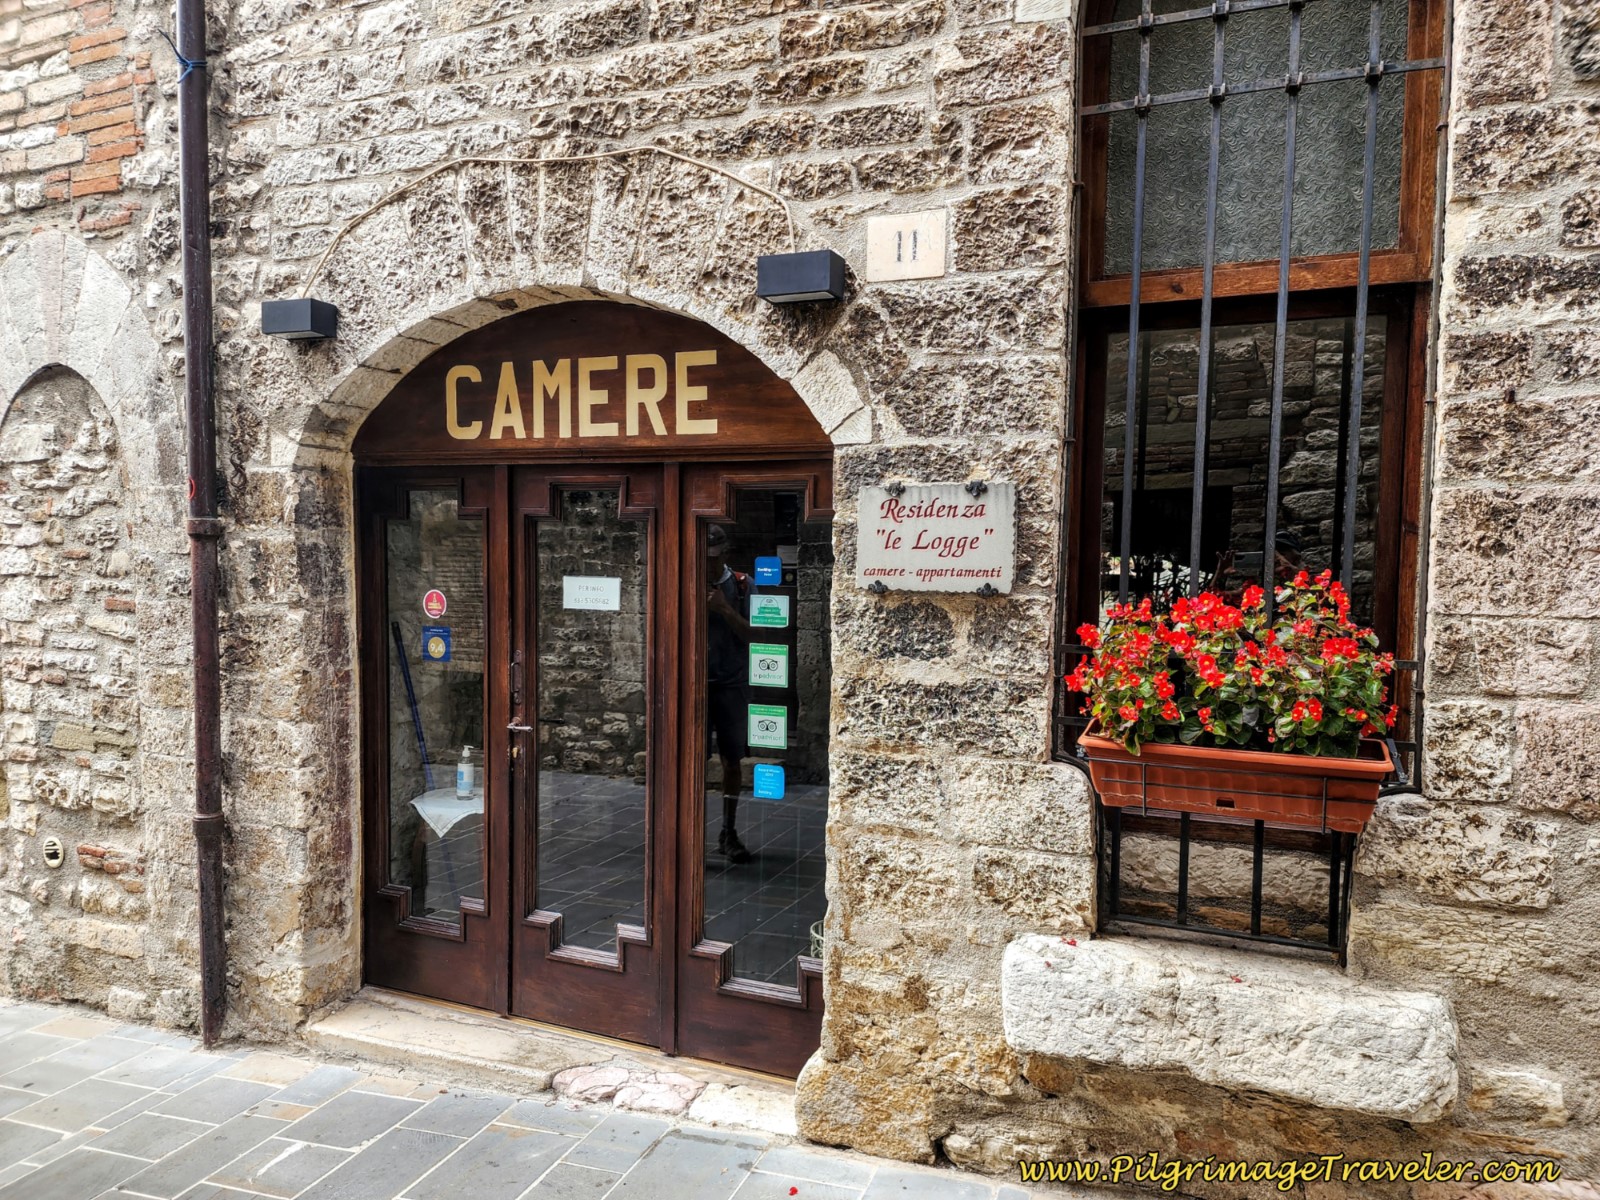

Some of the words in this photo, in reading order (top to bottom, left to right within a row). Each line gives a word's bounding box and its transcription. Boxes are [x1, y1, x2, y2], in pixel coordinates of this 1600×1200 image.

[893, 230, 919, 262] 11
[445, 350, 718, 440] CAMERE
[880, 497, 986, 524] Residenza
[876, 529, 902, 550] "le
[911, 528, 994, 558] Logge"
[863, 566, 905, 577] camere
[915, 566, 1002, 583] appartamenti
